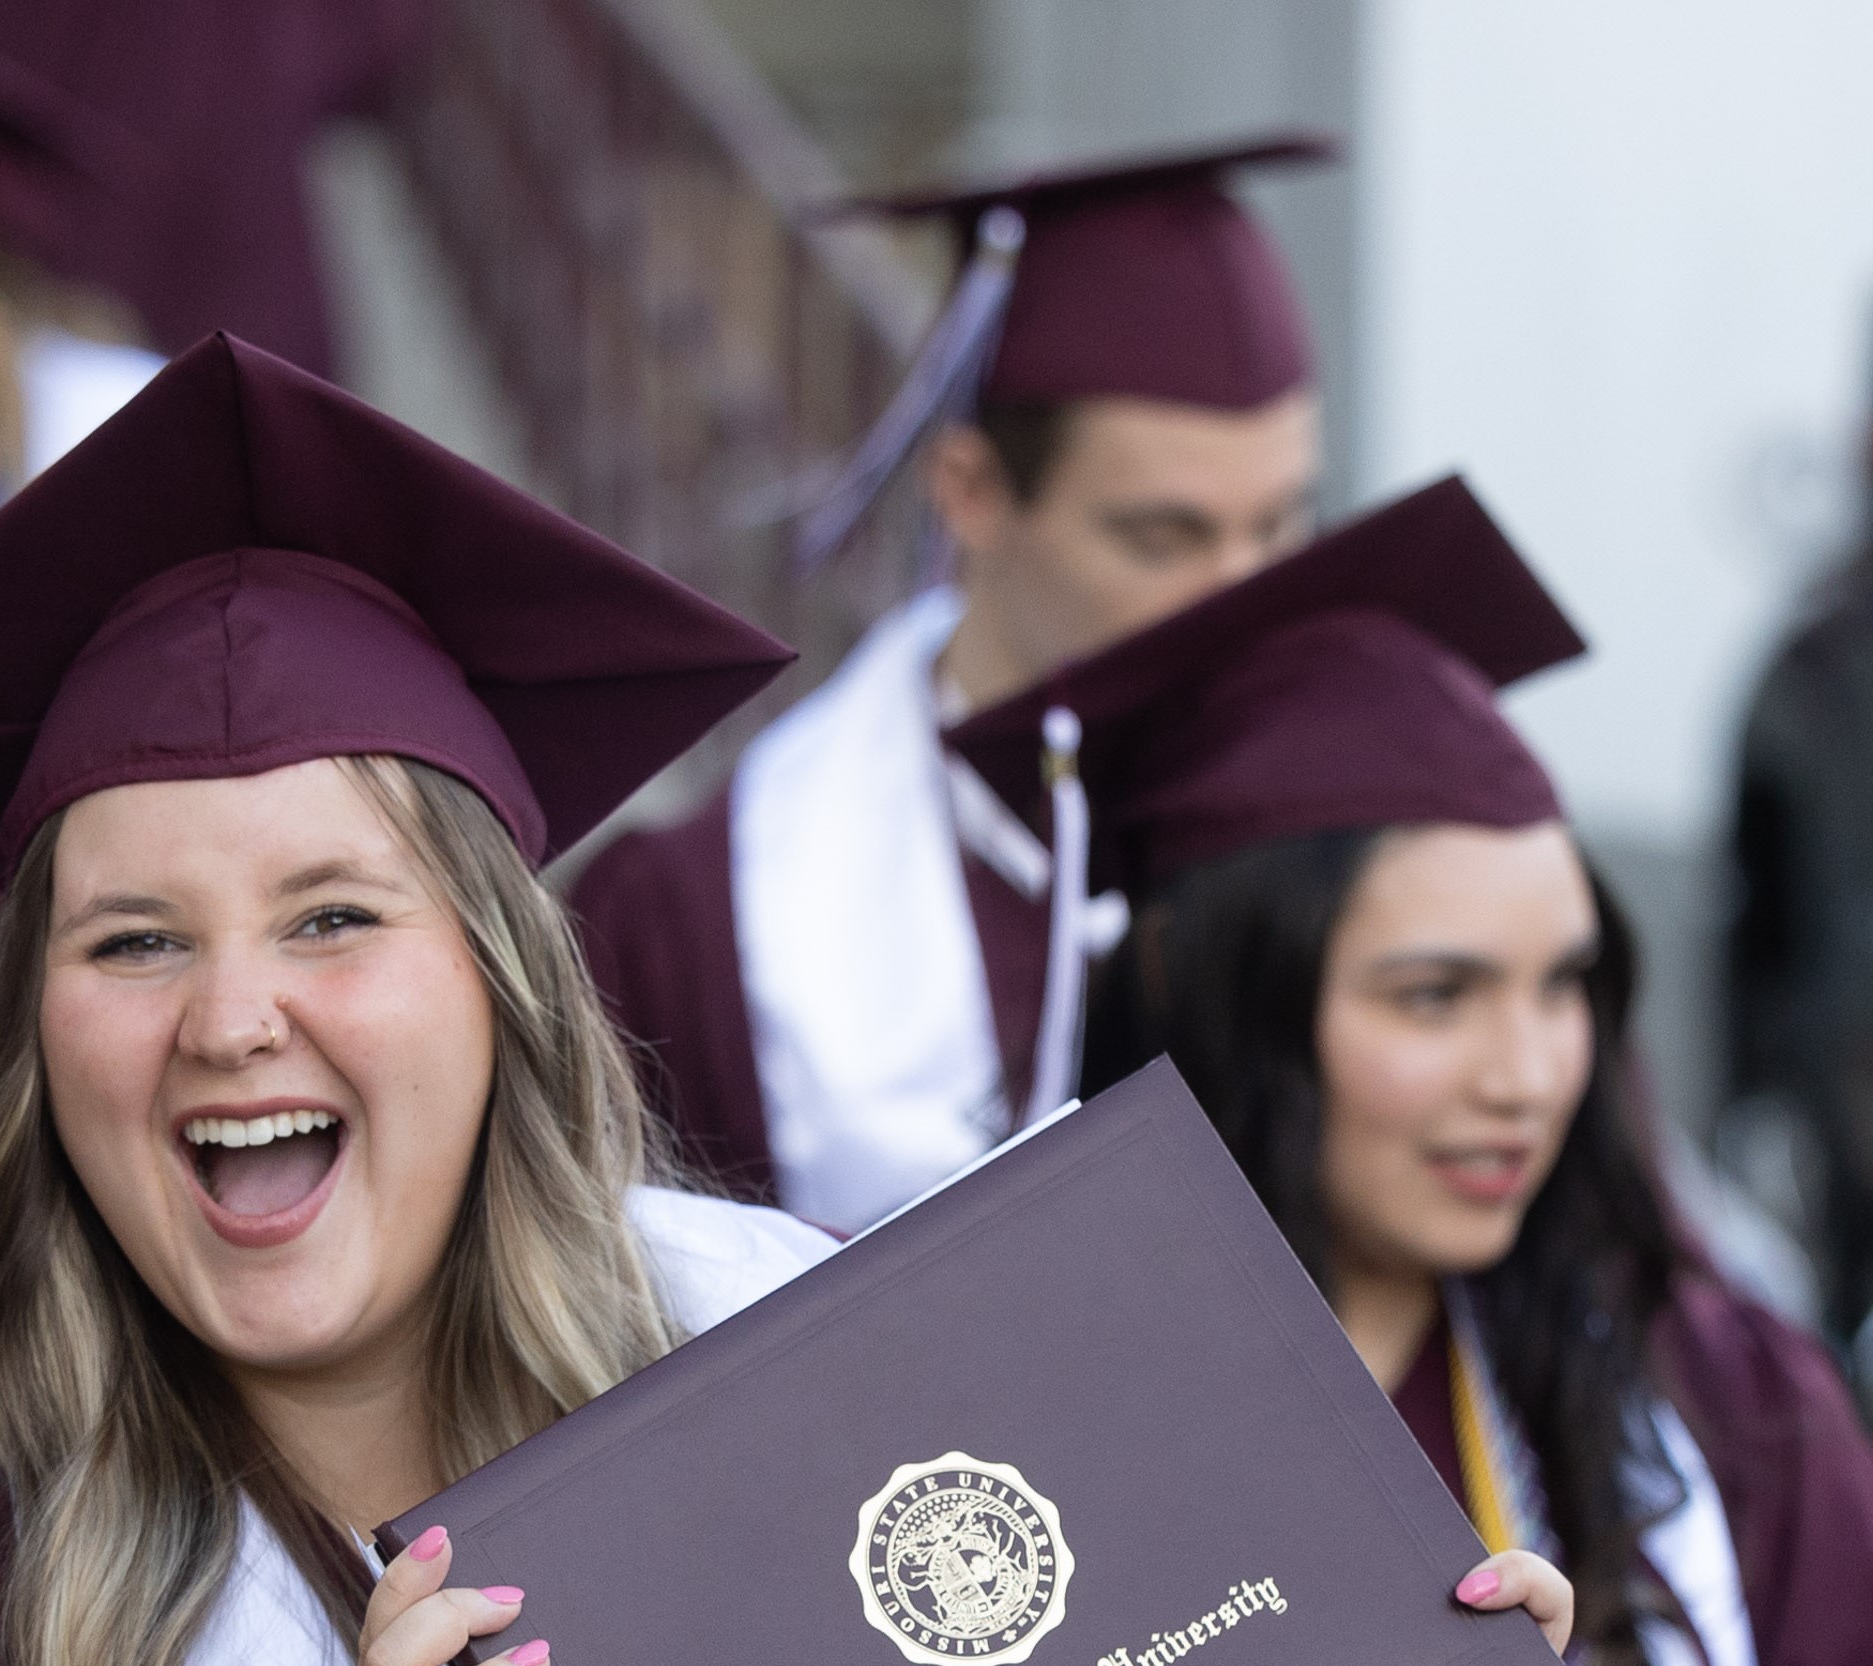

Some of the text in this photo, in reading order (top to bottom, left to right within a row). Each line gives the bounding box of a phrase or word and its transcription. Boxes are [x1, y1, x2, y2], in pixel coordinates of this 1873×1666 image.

[873, 1477, 939, 1546] STATE
[958, 1473, 1053, 1622] UNIVERSITY
[871, 1565, 990, 1654] MISSOURI
